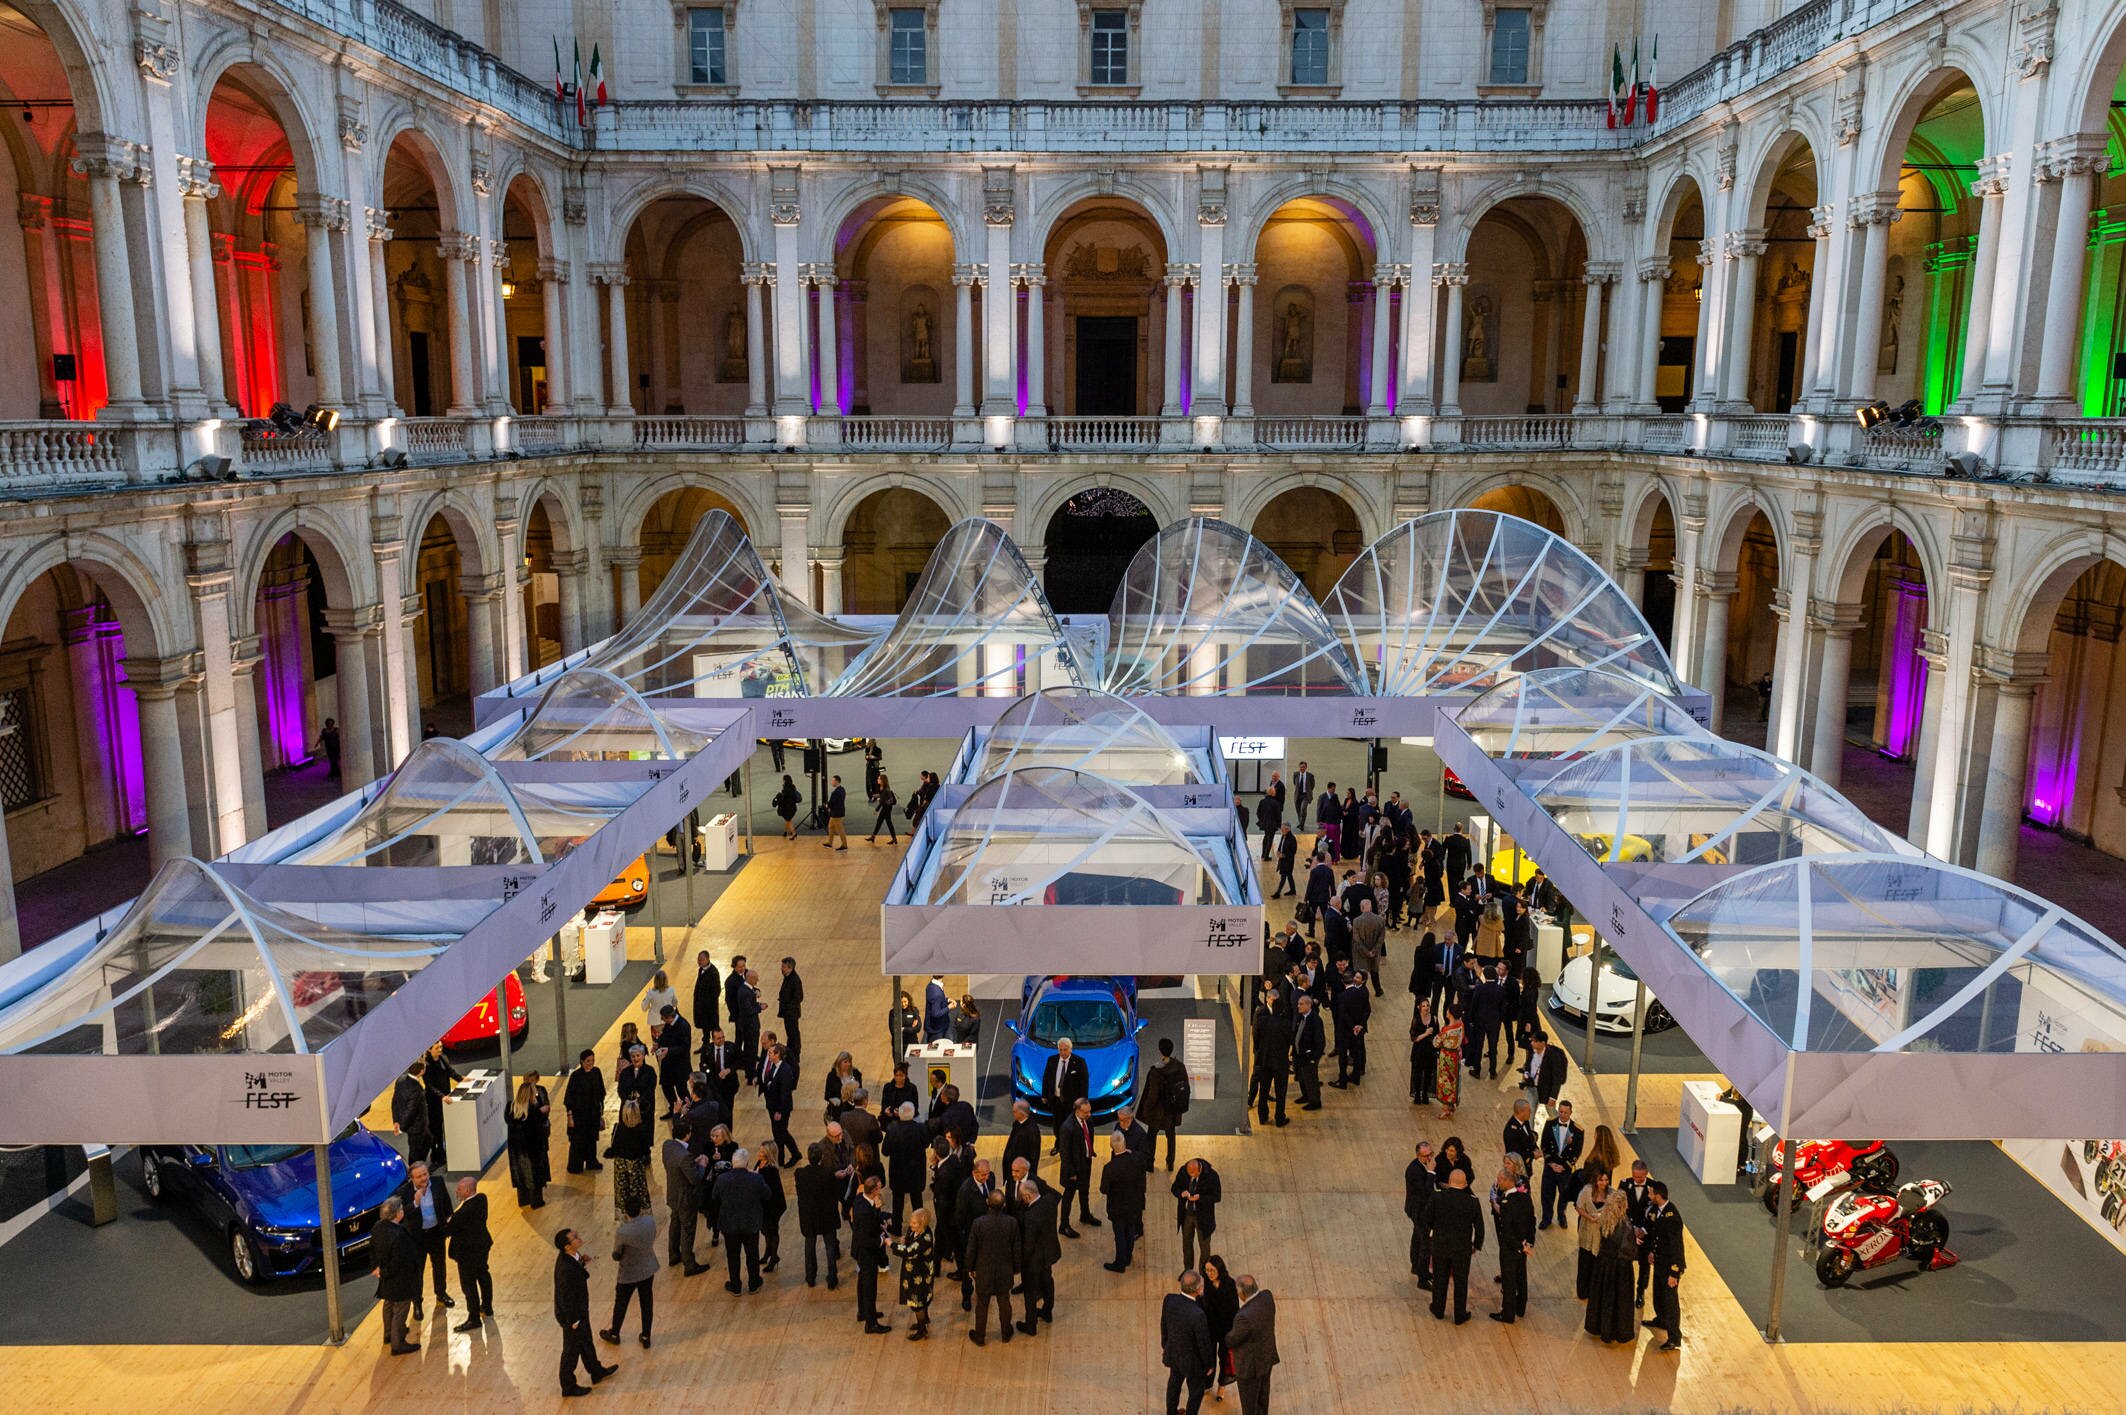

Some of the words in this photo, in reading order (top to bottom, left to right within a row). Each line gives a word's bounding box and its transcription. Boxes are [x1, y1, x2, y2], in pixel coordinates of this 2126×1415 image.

[1207, 934, 1251, 947] FEST
[474, 1002, 489, 1019] 7
[245, 1092, 297, 1109] FEST
[2111, 1162, 2126, 1180] 21
